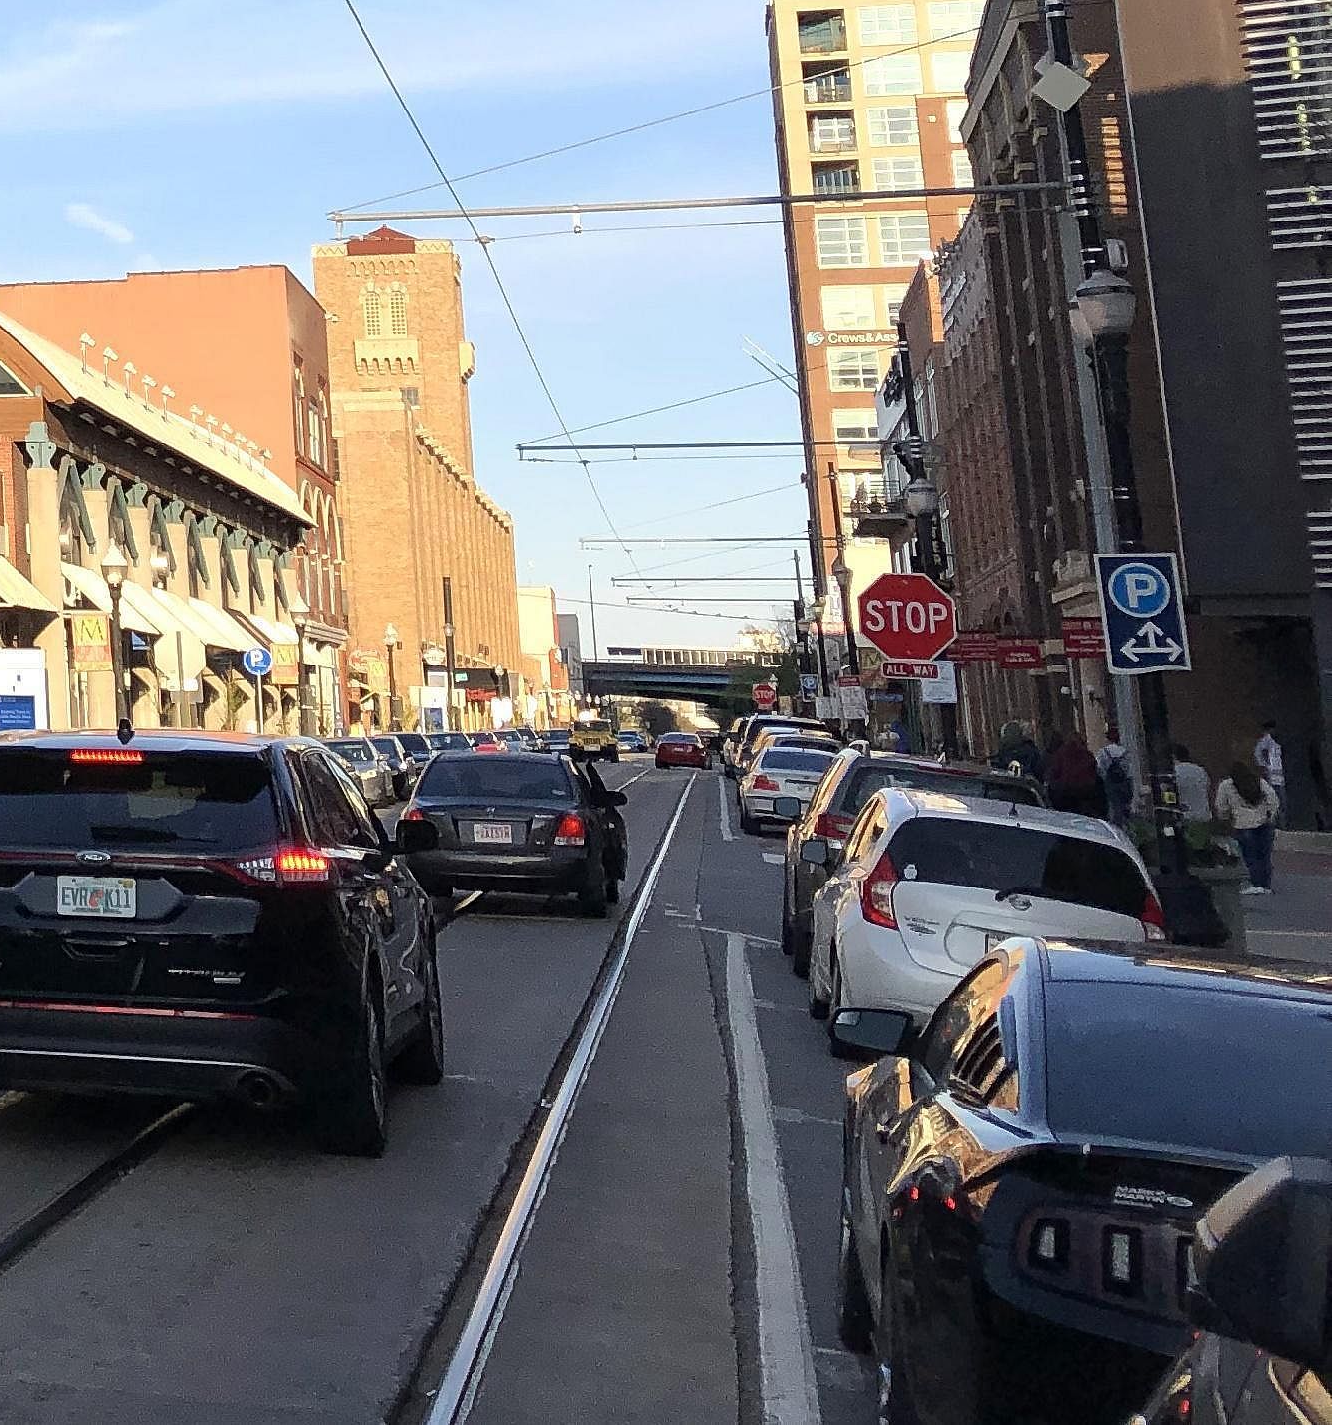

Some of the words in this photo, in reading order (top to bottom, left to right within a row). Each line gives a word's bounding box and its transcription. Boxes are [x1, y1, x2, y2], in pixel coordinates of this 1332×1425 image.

[1125, 573, 1157, 608] P
[865, 600, 948, 634] STOP
[886, 664, 907, 675] ALL
[912, 665, 934, 677] WAY
[754, 689, 775, 699] STOP
